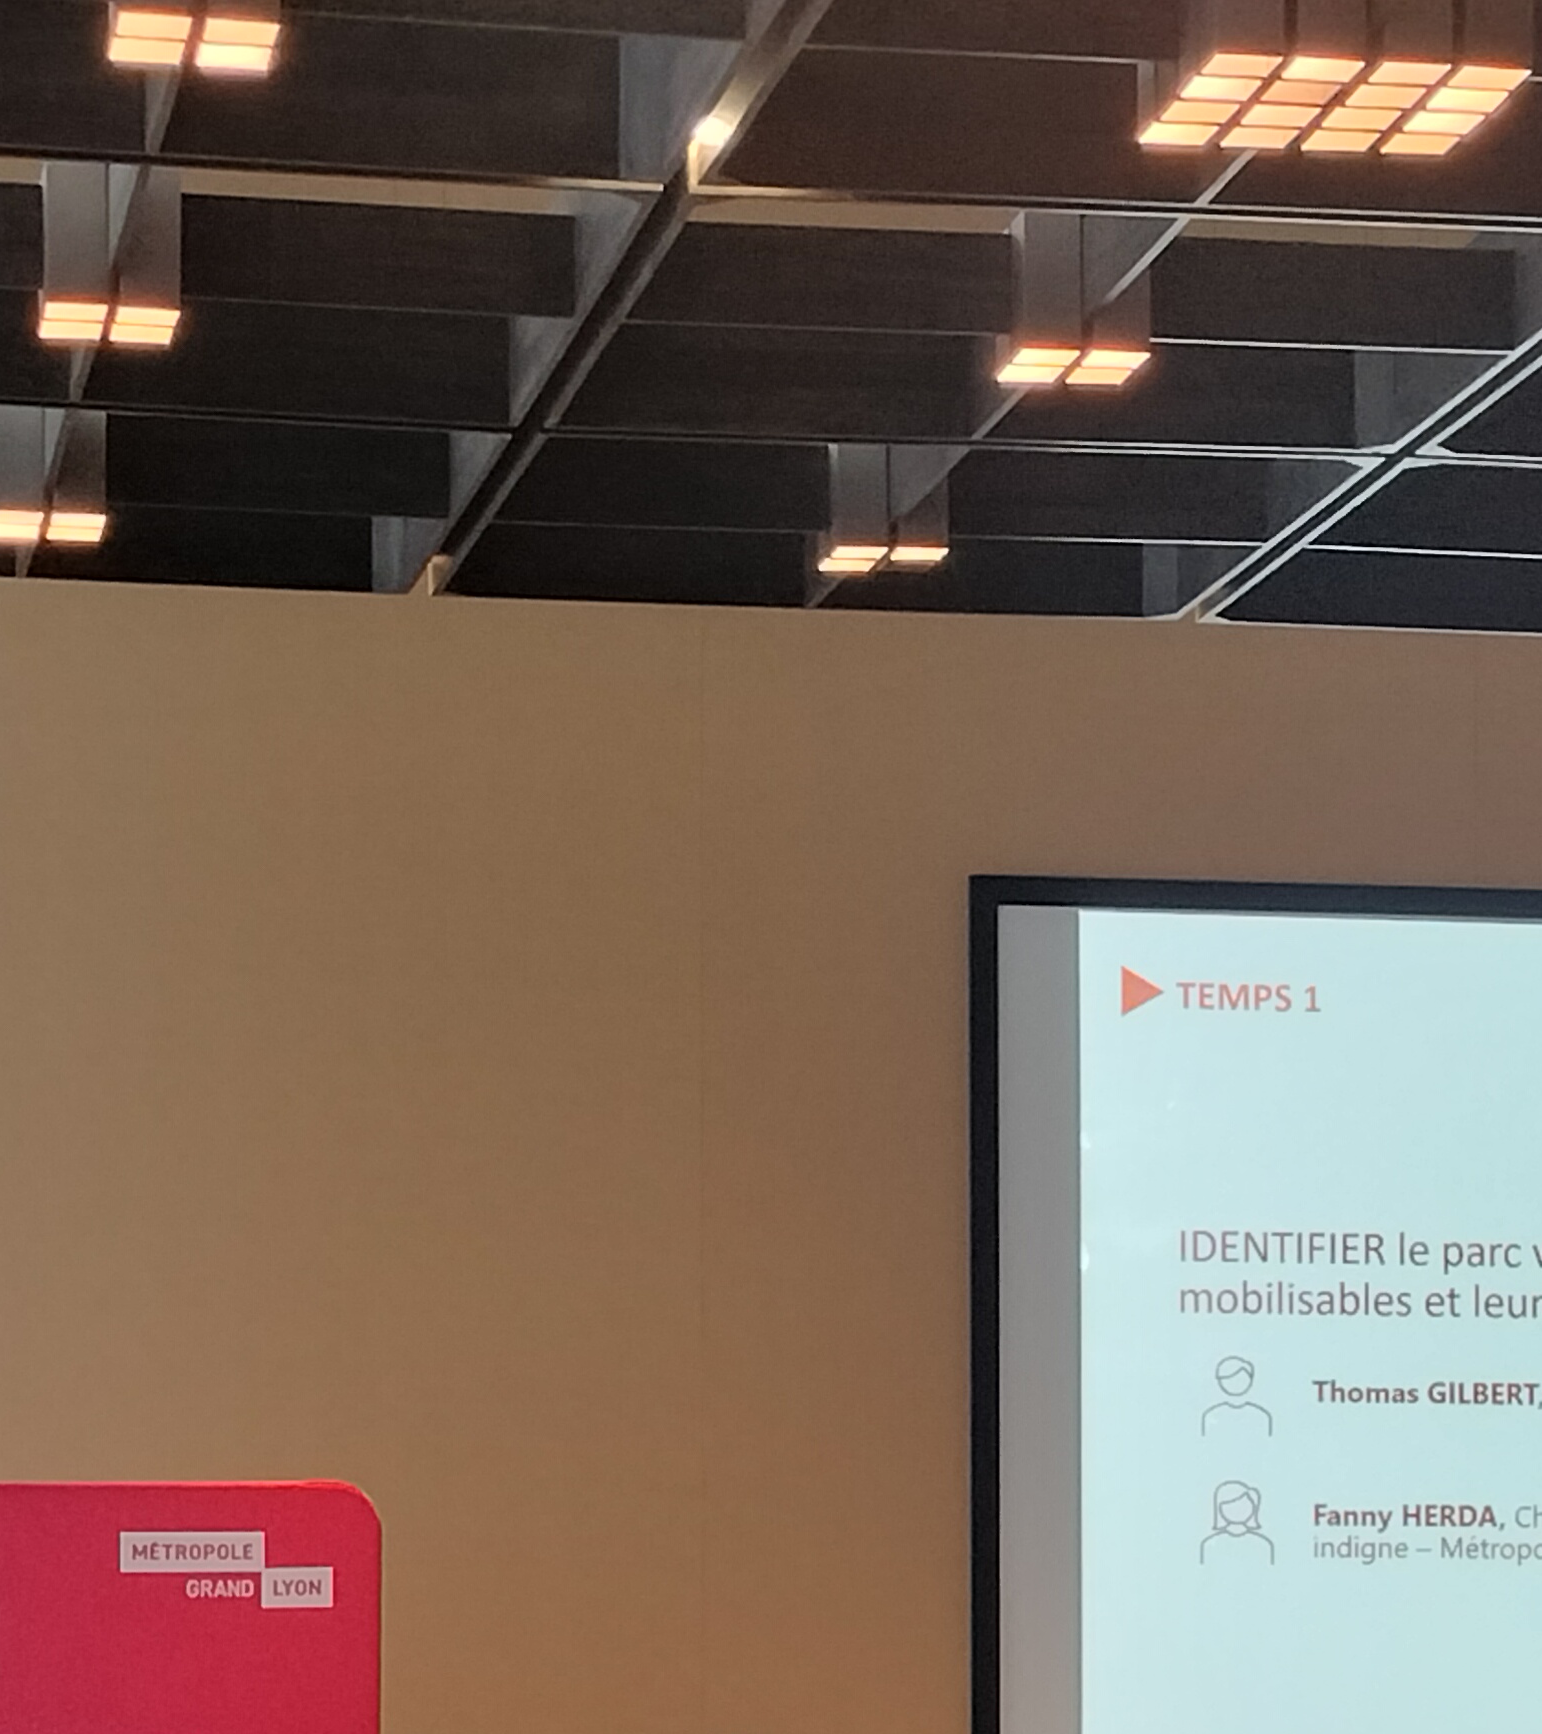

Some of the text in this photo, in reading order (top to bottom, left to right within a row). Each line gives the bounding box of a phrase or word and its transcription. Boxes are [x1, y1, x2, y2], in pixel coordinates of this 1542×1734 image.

[1176, 982, 1321, 1012] TEMPS 1
[1181, 1231, 1385, 1265] IDENTIFIER
[1400, 1232, 1429, 1266] le
[1444, 1242, 1521, 1275] parc
[1181, 1280, 1411, 1317] mobilisables
[1425, 1288, 1460, 1317] et
[1312, 1380, 1419, 1403] Thomas
[1428, 1382, 1542, 1409] GILBERT,
[1315, 1504, 1392, 1533] Fanny
[1403, 1505, 1504, 1530] HERDA,
[132, 1542, 253, 1560] MÉTROPOLE
[1314, 1535, 1408, 1565] indigne
[186, 1579, 321, 1598] GRAND LYON
